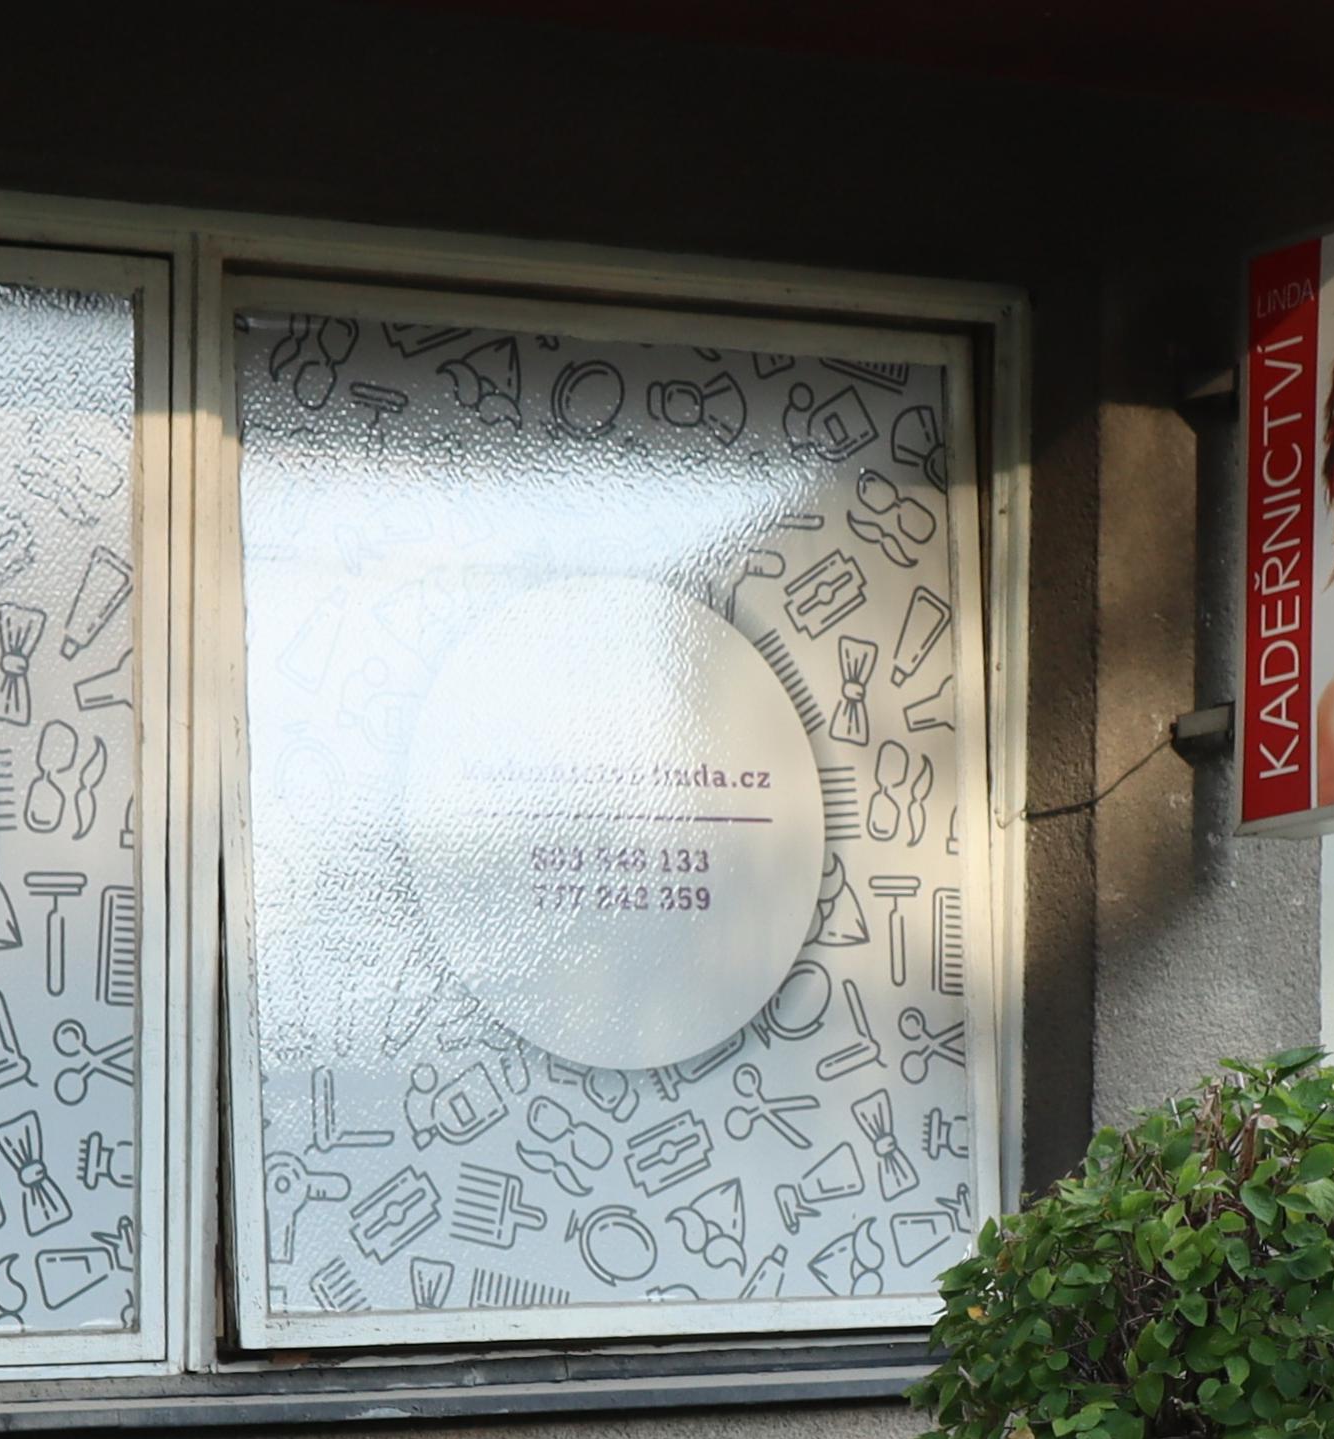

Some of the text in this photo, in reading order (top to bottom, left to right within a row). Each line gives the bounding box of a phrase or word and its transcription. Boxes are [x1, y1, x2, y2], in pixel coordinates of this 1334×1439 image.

[1256, 277, 1317, 320] LINDA
[1254, 334, 1305, 780] KADEŘNICTVÍ
[660, 848, 710, 873] 133
[660, 886, 712, 911] 359
